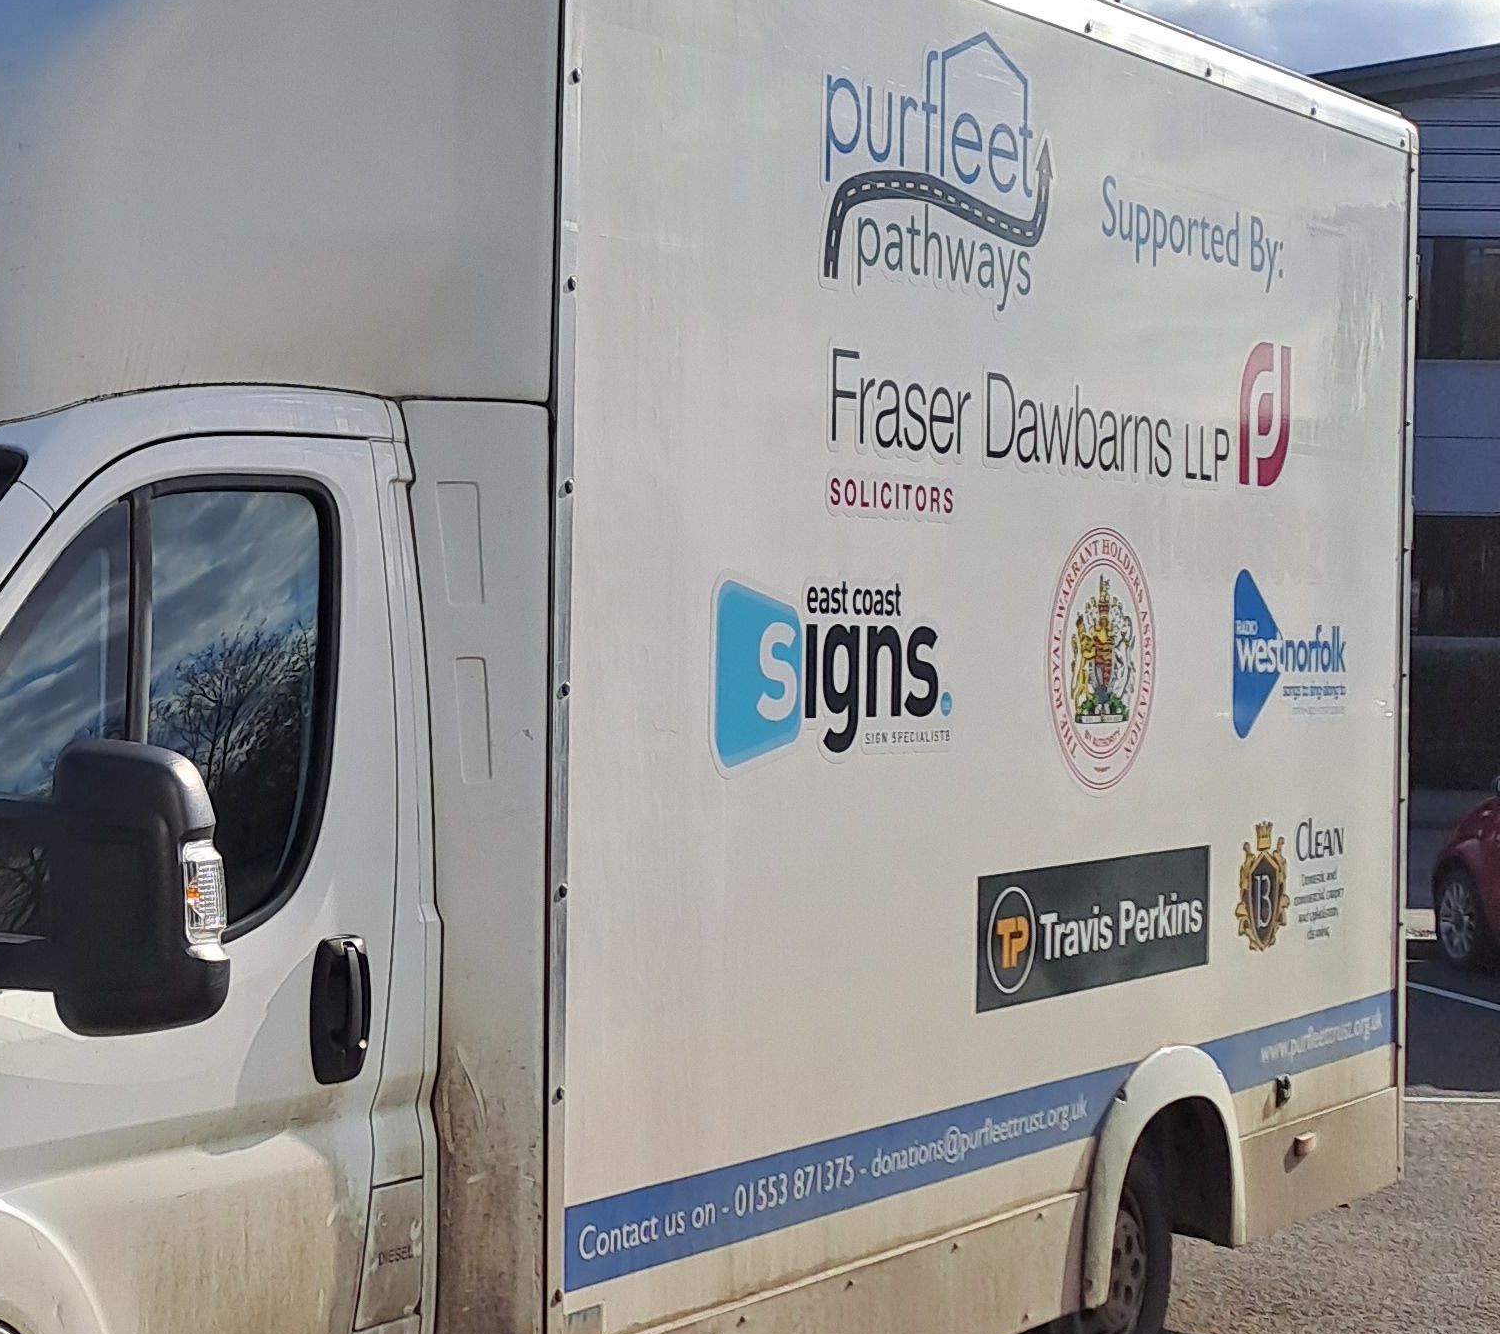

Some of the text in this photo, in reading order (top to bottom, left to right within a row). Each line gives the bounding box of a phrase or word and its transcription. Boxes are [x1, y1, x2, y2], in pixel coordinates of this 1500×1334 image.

[826, 50, 1034, 198] purfleet
[857, 204, 1031, 312] pathways
[1102, 175, 1284, 293] Supported By:
[831, 348, 1230, 483] Fraser Dawbarns LLP
[830, 477, 954, 514] SOLICITORS
[806, 581, 902, 616] east coast
[1039, 905, 1114, 961] Travis
[1117, 892, 1204, 947] Perkins
[578, 1217, 660, 1260] Contact
[664, 1210, 686, 1238] us
[690, 1202, 716, 1230] on
[733, 1171, 789, 1218] 01553
[792, 1154, 855, 1200] 871375
[871, 1093, 1089, 1178] donations@purfleettrust.org.uk
